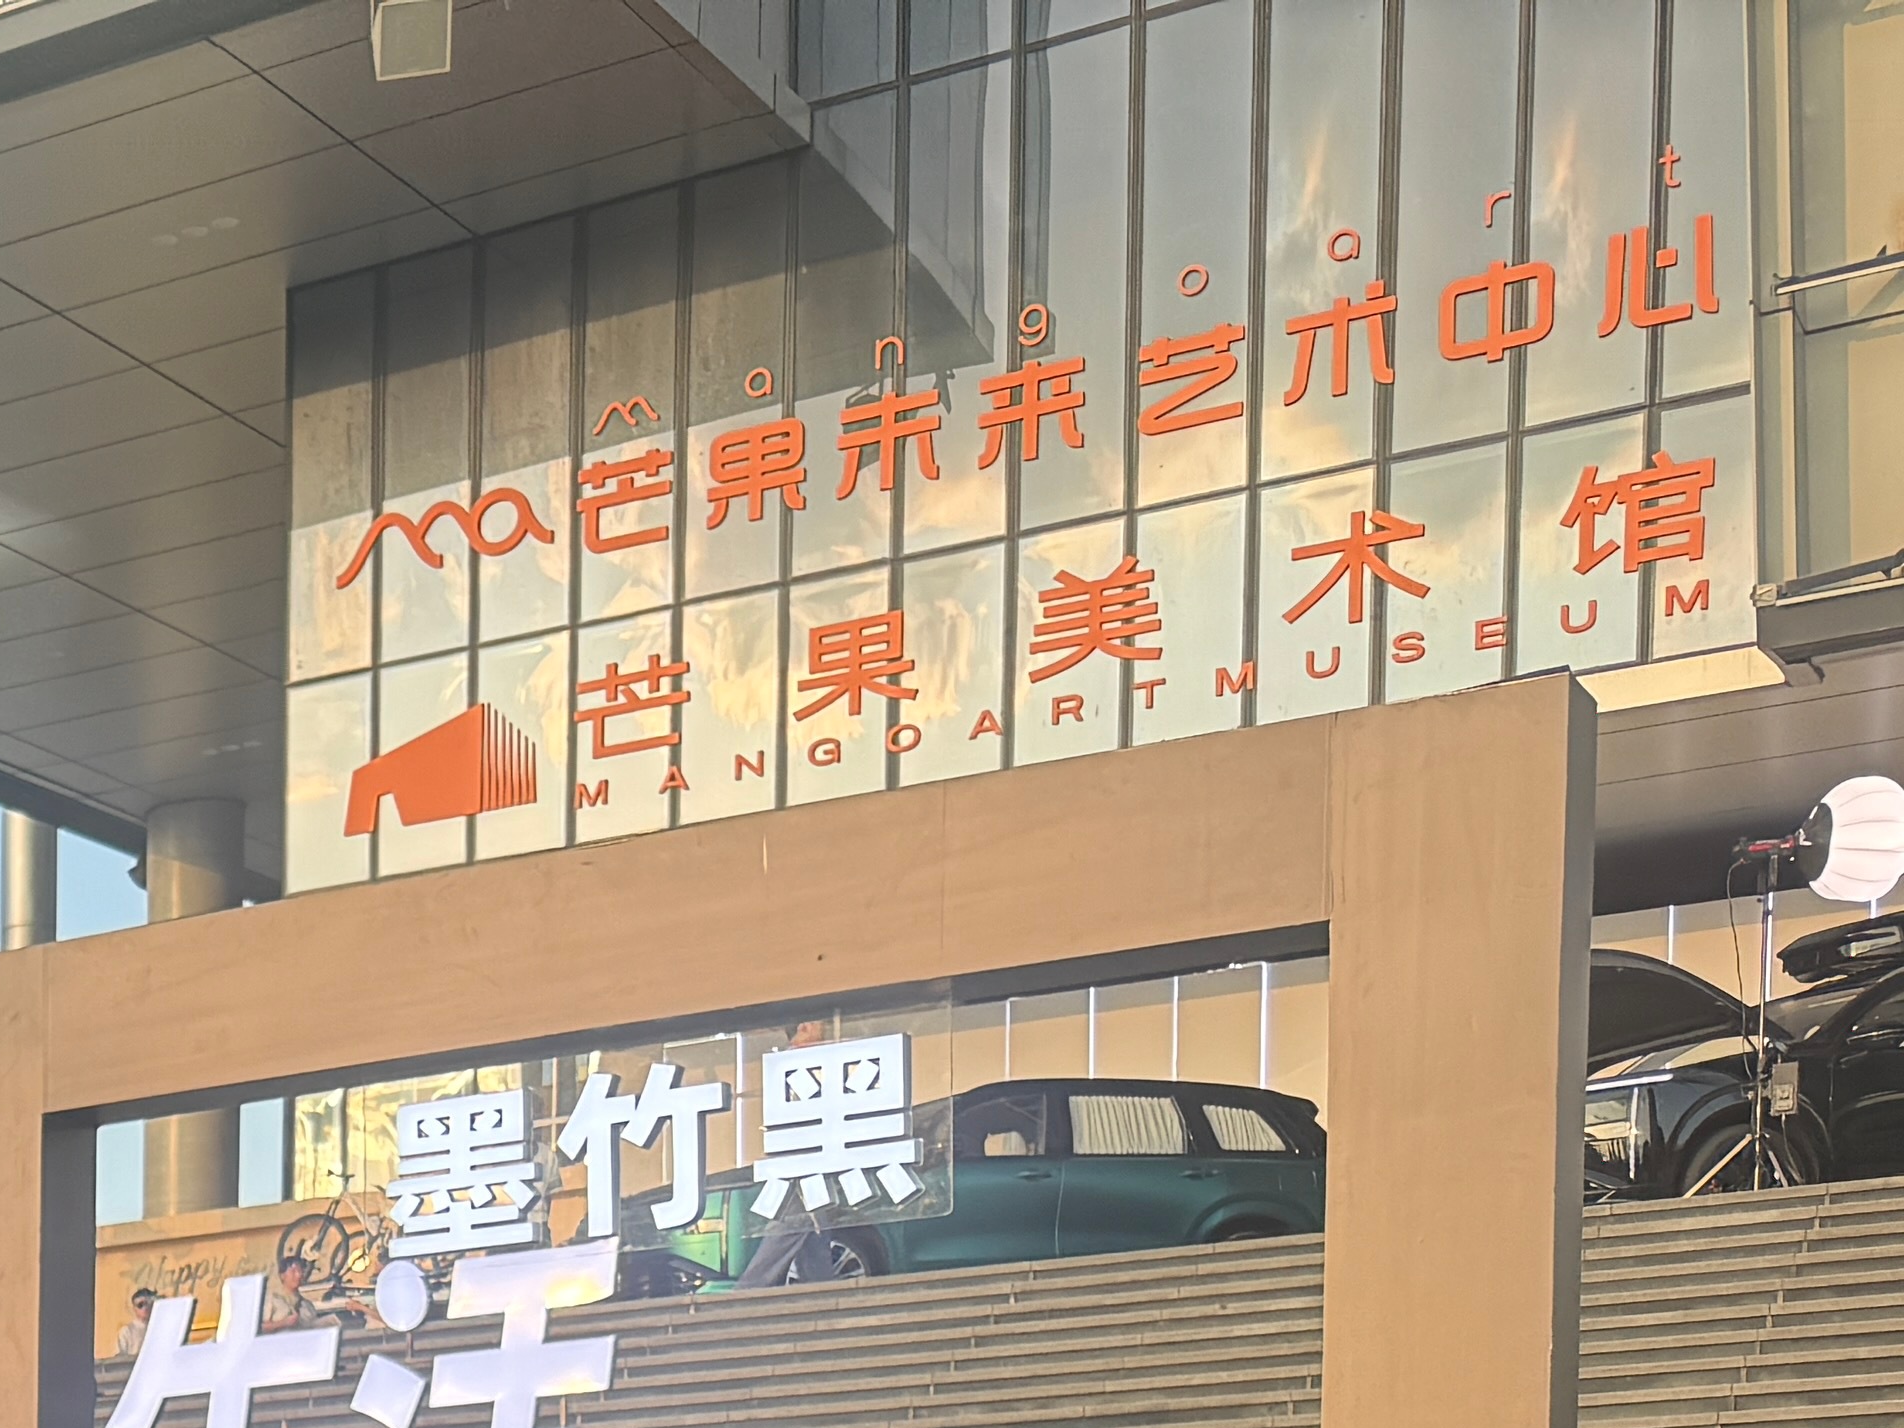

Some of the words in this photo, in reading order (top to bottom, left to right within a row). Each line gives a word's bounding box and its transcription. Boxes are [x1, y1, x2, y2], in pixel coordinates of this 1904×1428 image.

[576, 213, 1720, 555] 芒果未来艺术中心
[573, 450, 1716, 760] 芒果美术馆
[1214, 578, 1711, 697] MUSEUM
[389, 1033, 924, 1259] 墨竹黑
